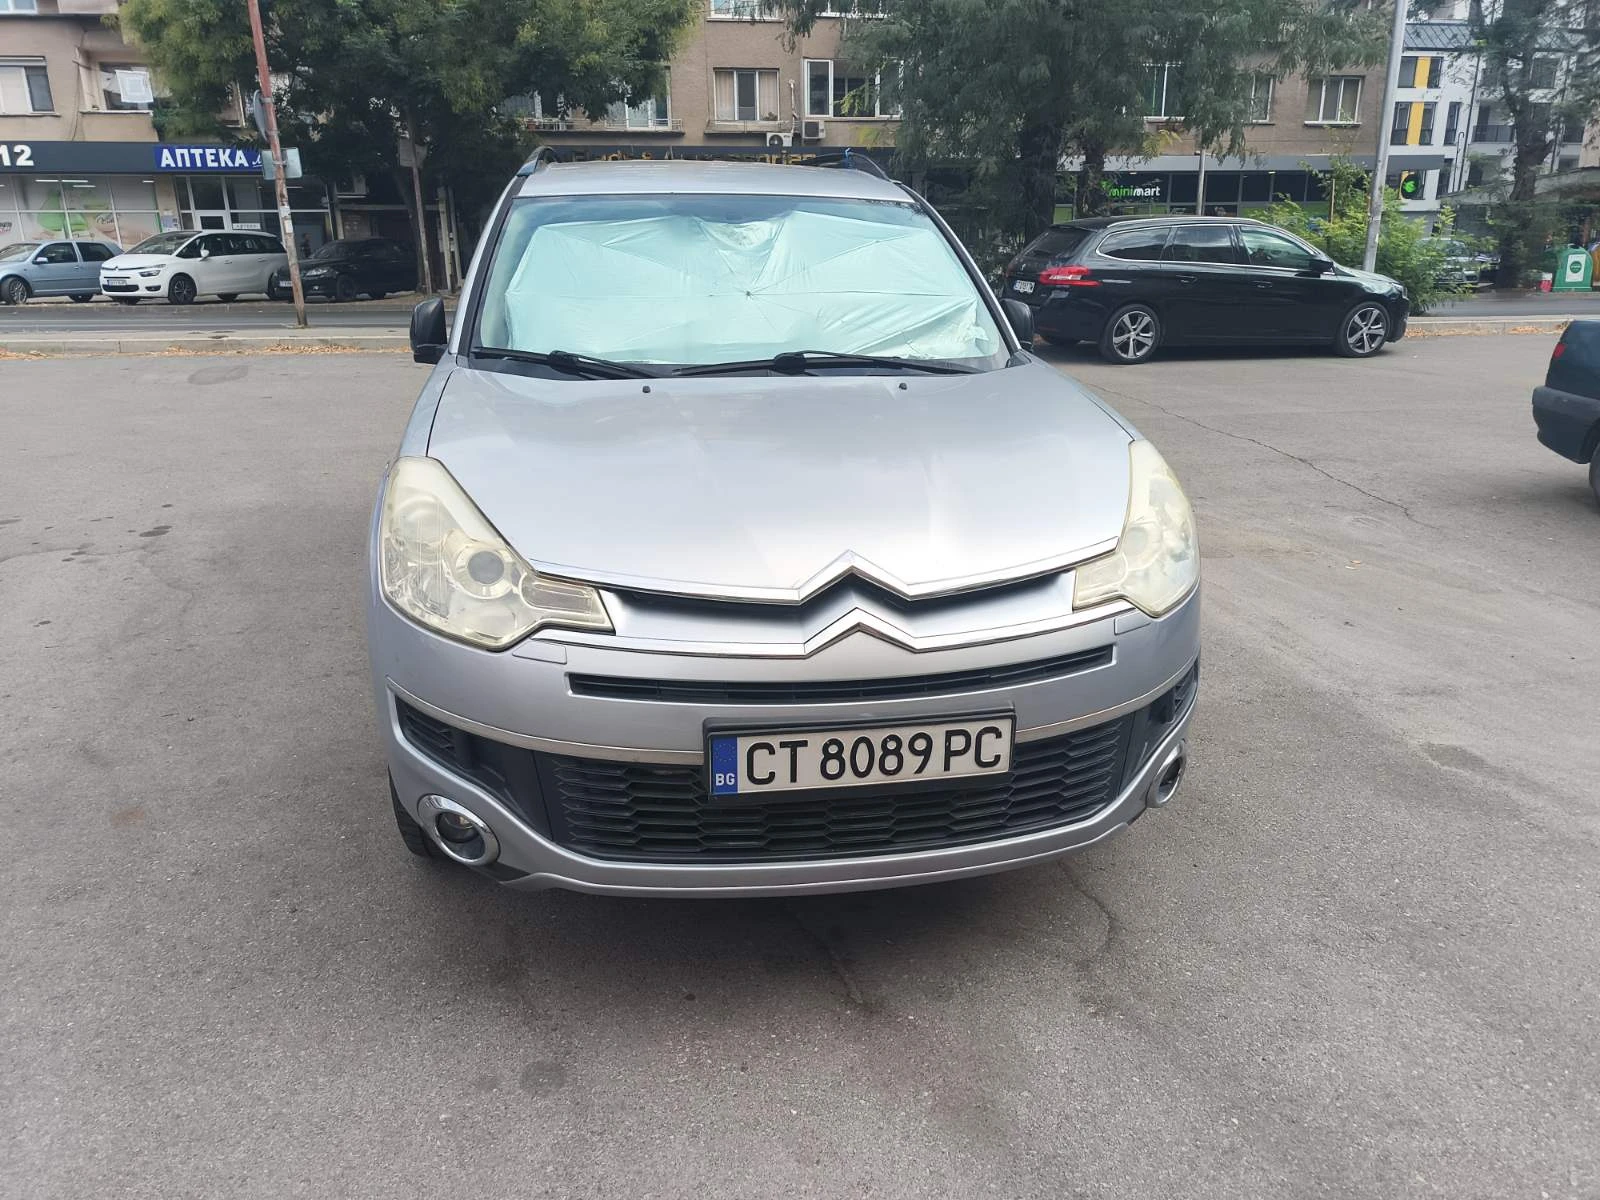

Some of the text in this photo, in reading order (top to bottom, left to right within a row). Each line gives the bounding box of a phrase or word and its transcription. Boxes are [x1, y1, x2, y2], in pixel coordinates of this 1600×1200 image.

[160, 148, 250, 168] АПТЕКА
[746, 725, 1003, 785] CT 8089 PC
[715, 772, 735, 786] BG
